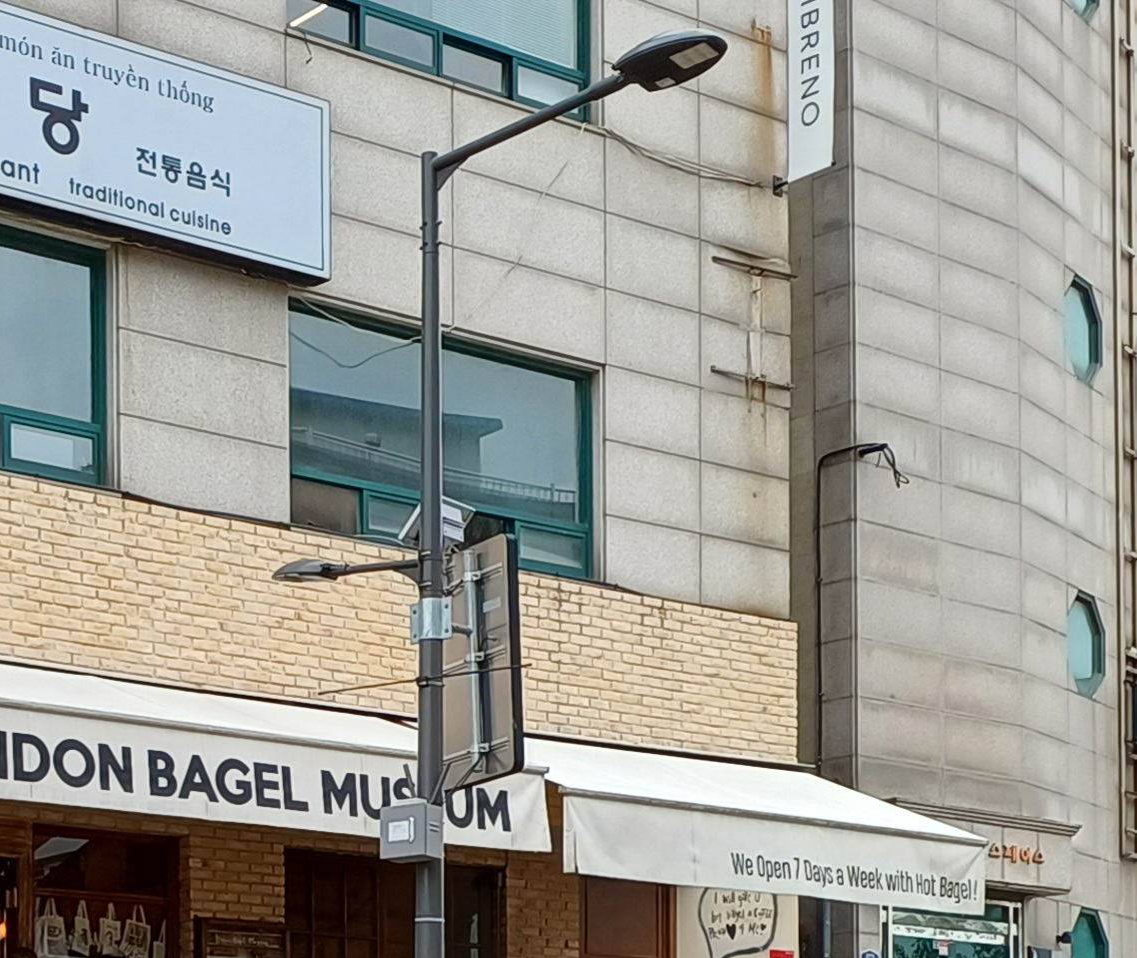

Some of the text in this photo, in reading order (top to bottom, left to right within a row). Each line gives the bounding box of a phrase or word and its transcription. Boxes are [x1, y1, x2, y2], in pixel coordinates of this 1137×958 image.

[51, 46, 75, 70] ăn
[83, 55, 151, 94] truyền
[157, 79, 215, 114] thống
[135, 146, 232, 197] 전통음식
[68, 177, 232, 236] traditional cuisine
[147, 750, 307, 813] BAGEL
[730, 851, 753, 877] We
[757, 855, 791, 882] Open
[793, 857, 800, 881] 7
[803, 859, 834, 888] Days
[836, 869, 844, 886] a
[846, 865, 883, 891] Week
[885, 870, 914, 893] with
[916, 873, 936, 897] Hot
